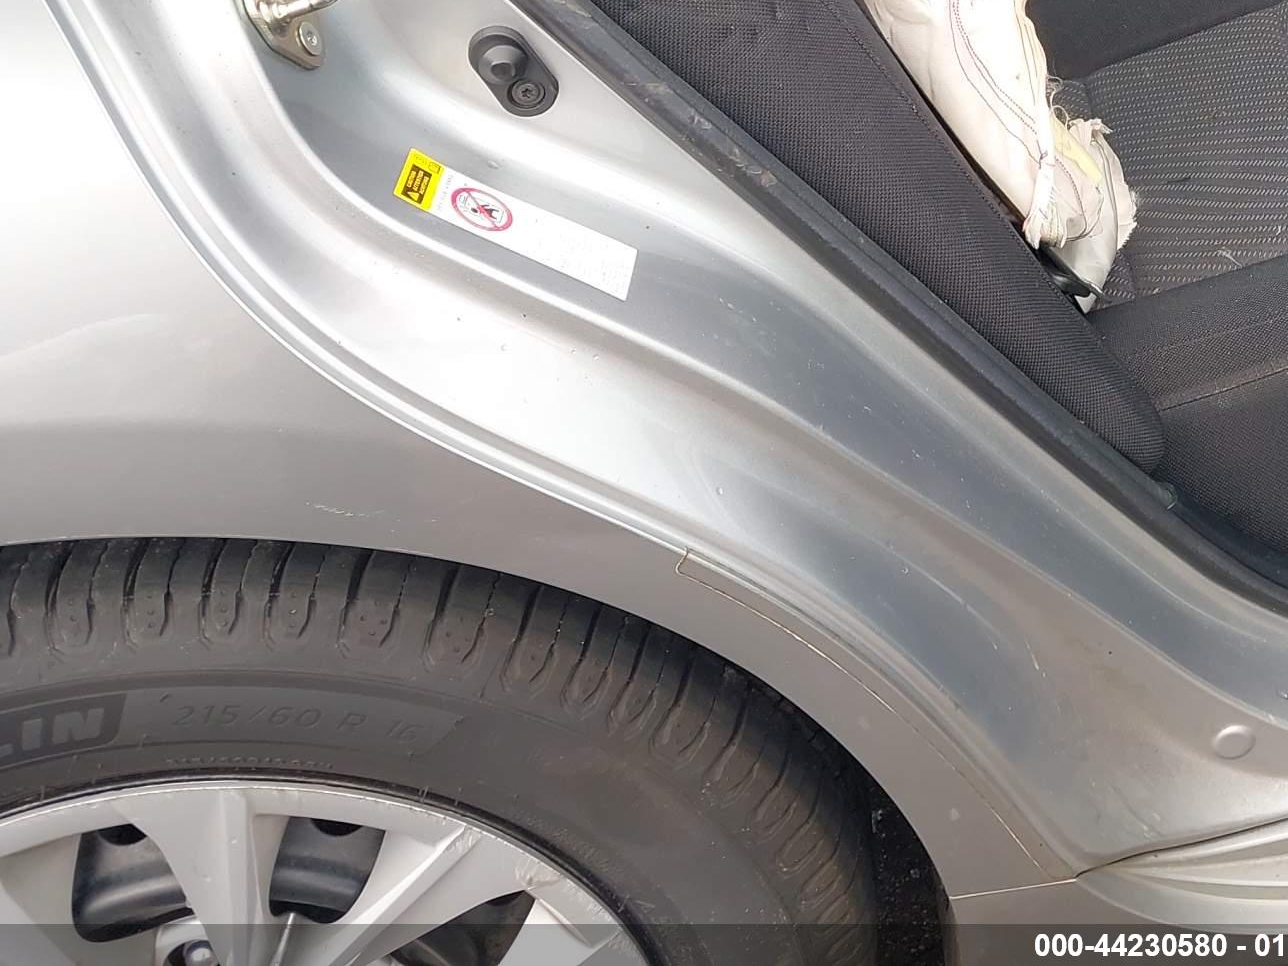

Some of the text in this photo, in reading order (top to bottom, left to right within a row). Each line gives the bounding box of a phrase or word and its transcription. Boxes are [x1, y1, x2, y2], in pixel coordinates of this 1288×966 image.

[172, 704, 422, 742] 215/60 R 16
